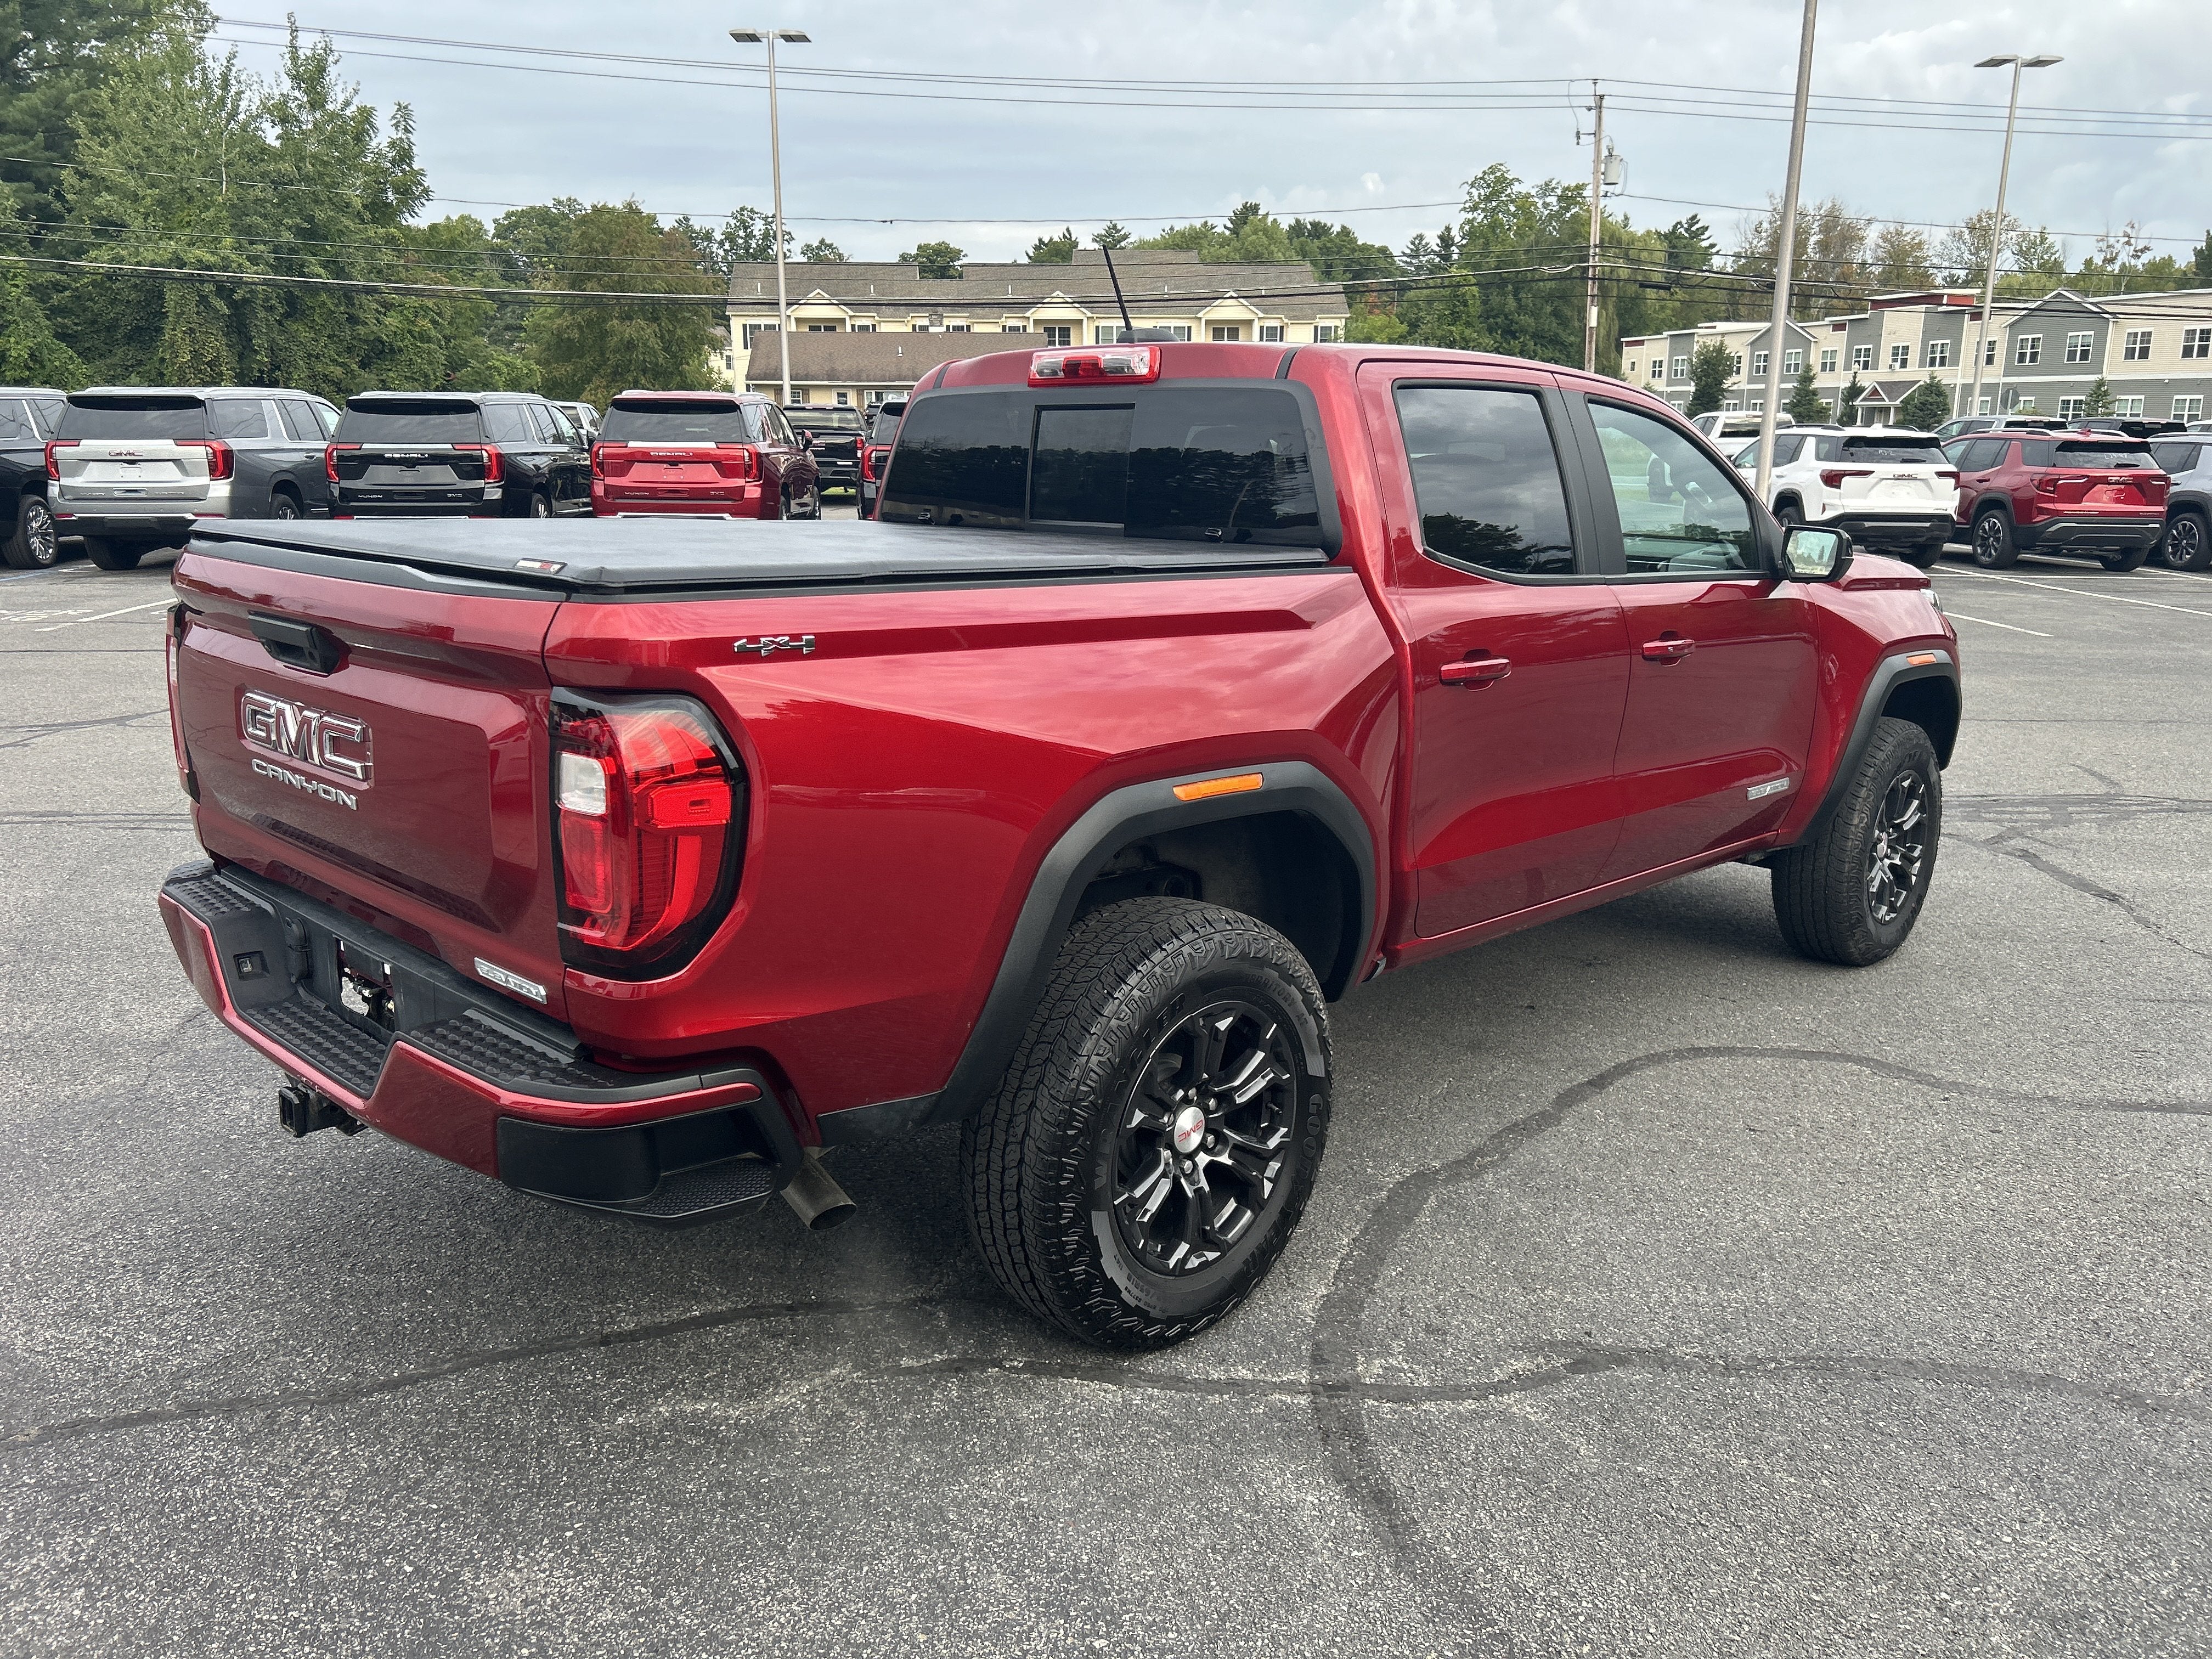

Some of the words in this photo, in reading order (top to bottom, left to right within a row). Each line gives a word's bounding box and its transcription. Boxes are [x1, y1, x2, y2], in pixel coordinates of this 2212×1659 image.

[241, 691, 369, 781] GMC
[251, 758, 359, 811] CANYON
[1177, 1119, 1204, 1143] GMC
